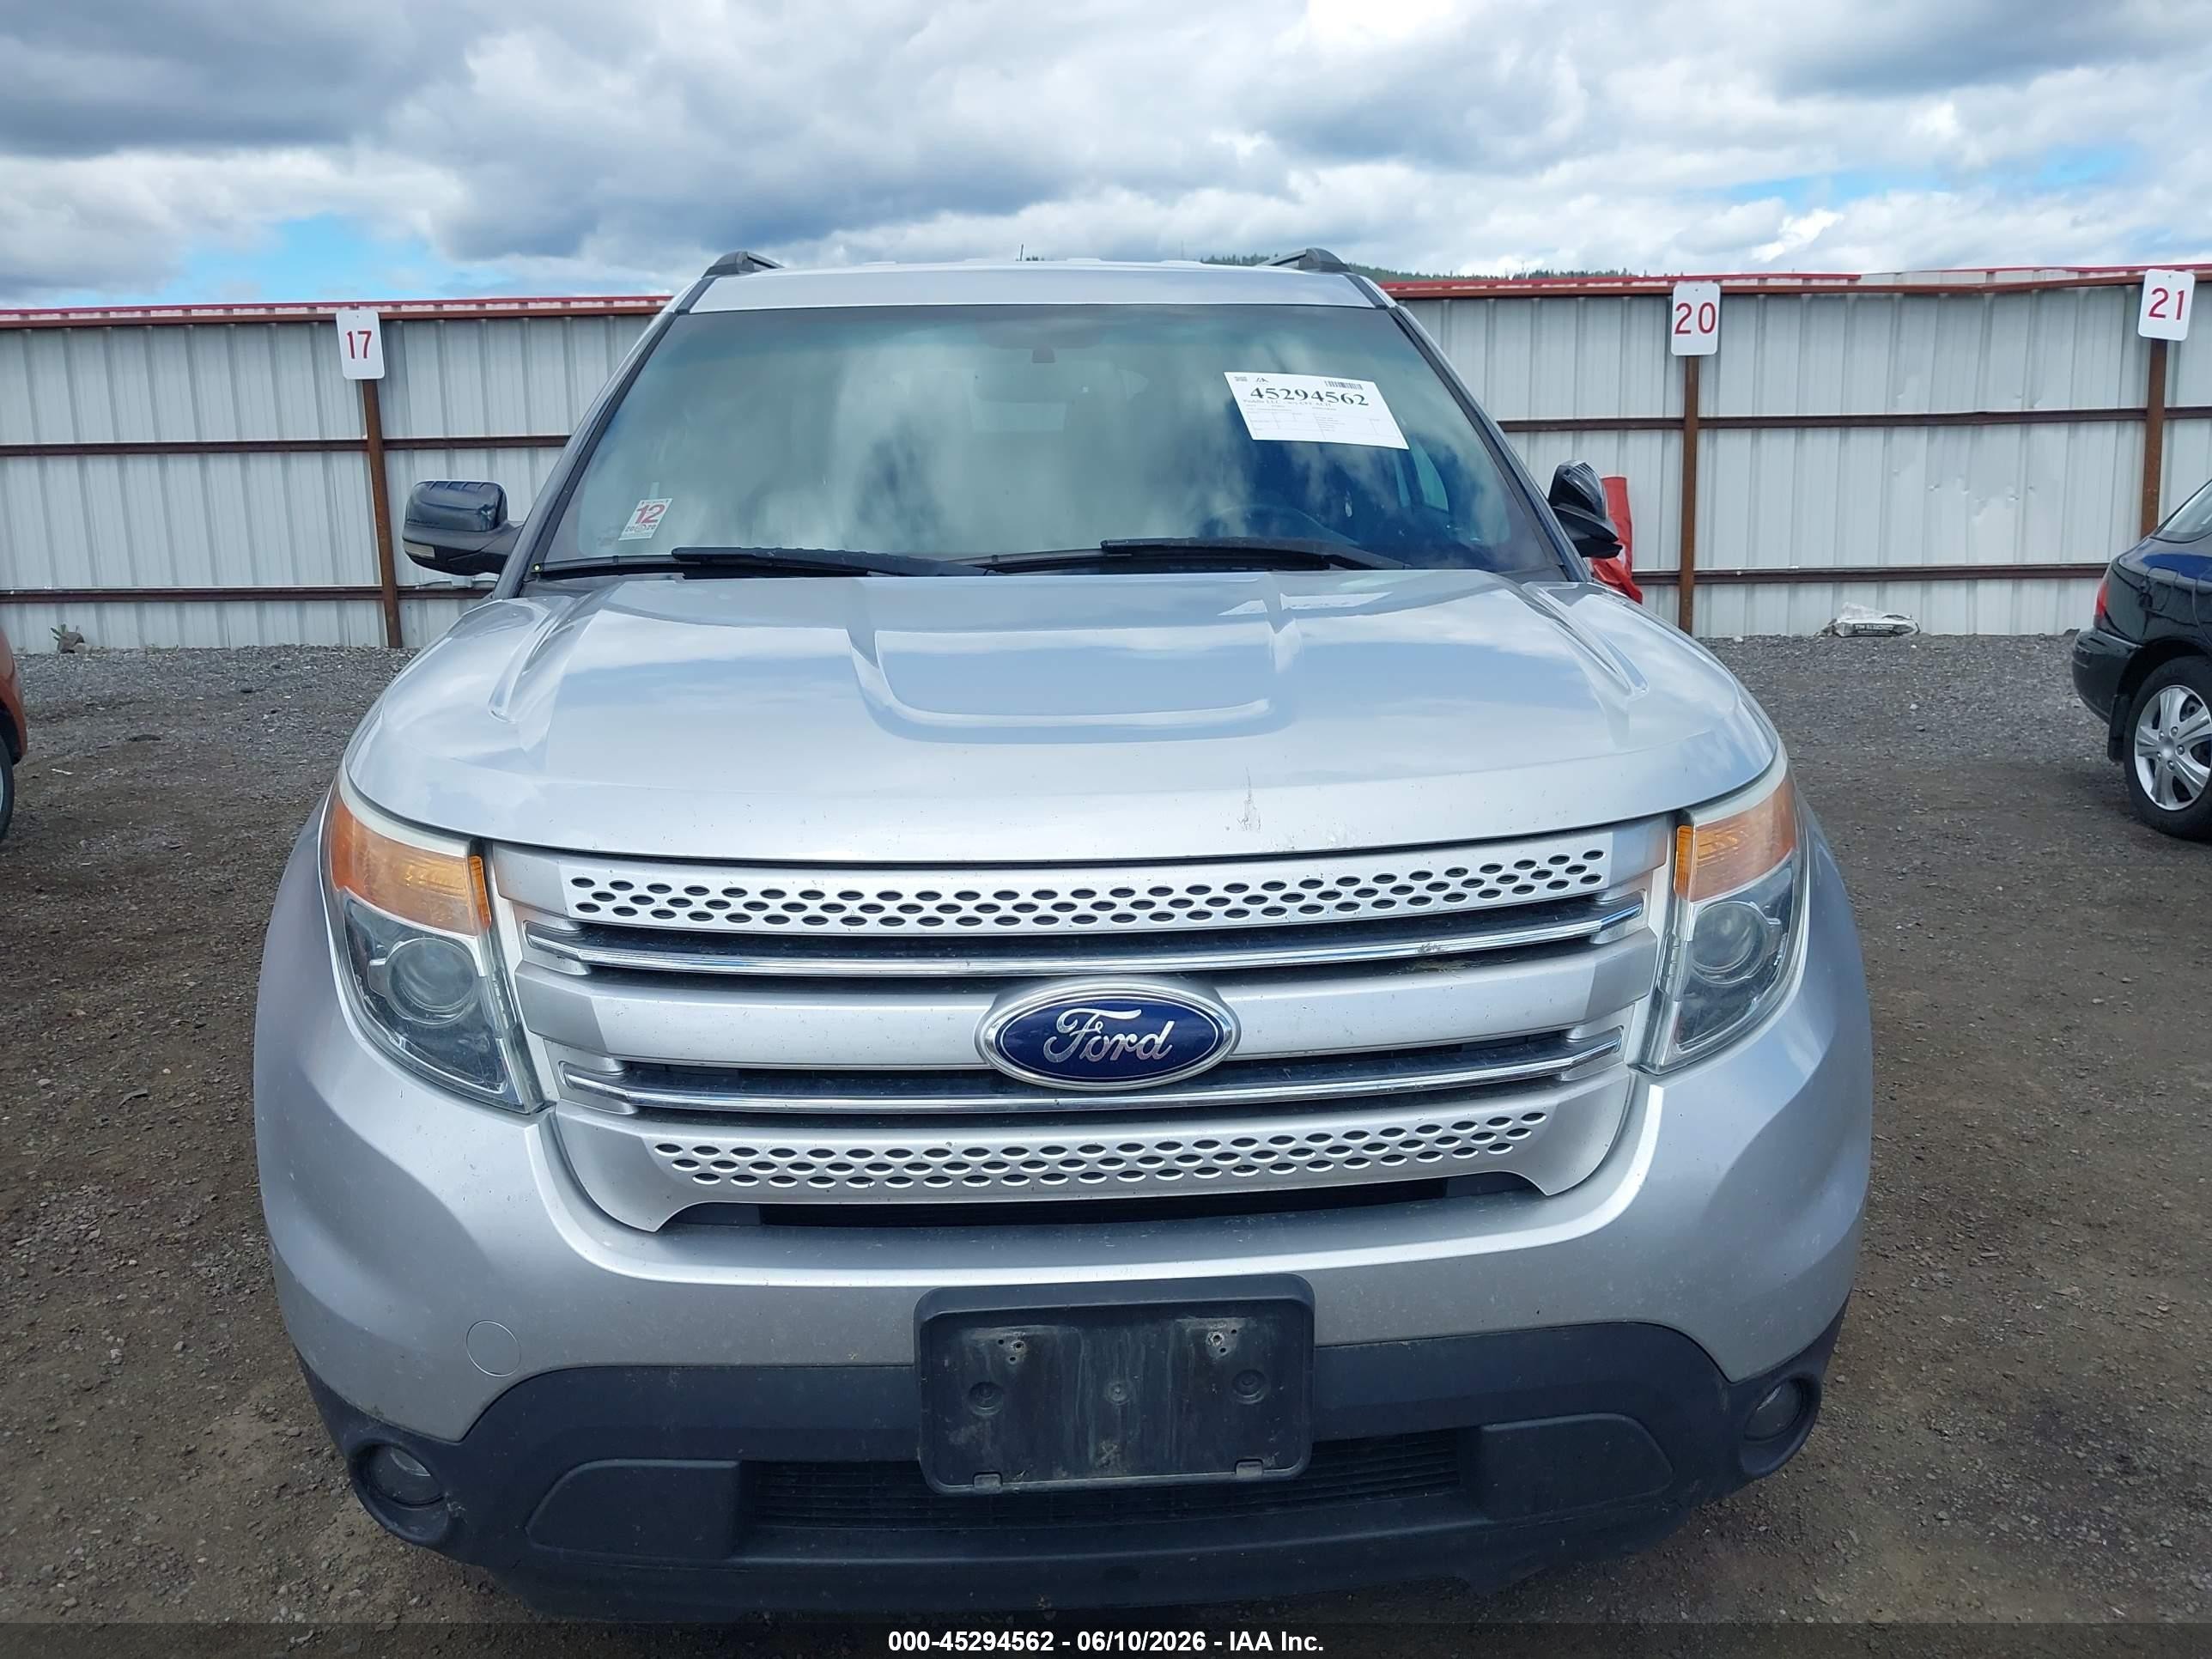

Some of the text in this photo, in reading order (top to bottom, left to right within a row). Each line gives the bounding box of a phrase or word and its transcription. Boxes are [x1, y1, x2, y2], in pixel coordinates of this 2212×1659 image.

[1674, 302, 1716, 334] 20
[2148, 288, 2185, 320] 21
[346, 331, 372, 359] 17
[1250, 387, 1369, 406] 45294562
[635, 503, 665, 524] 12
[1043, 1008, 1175, 1062] Ford
